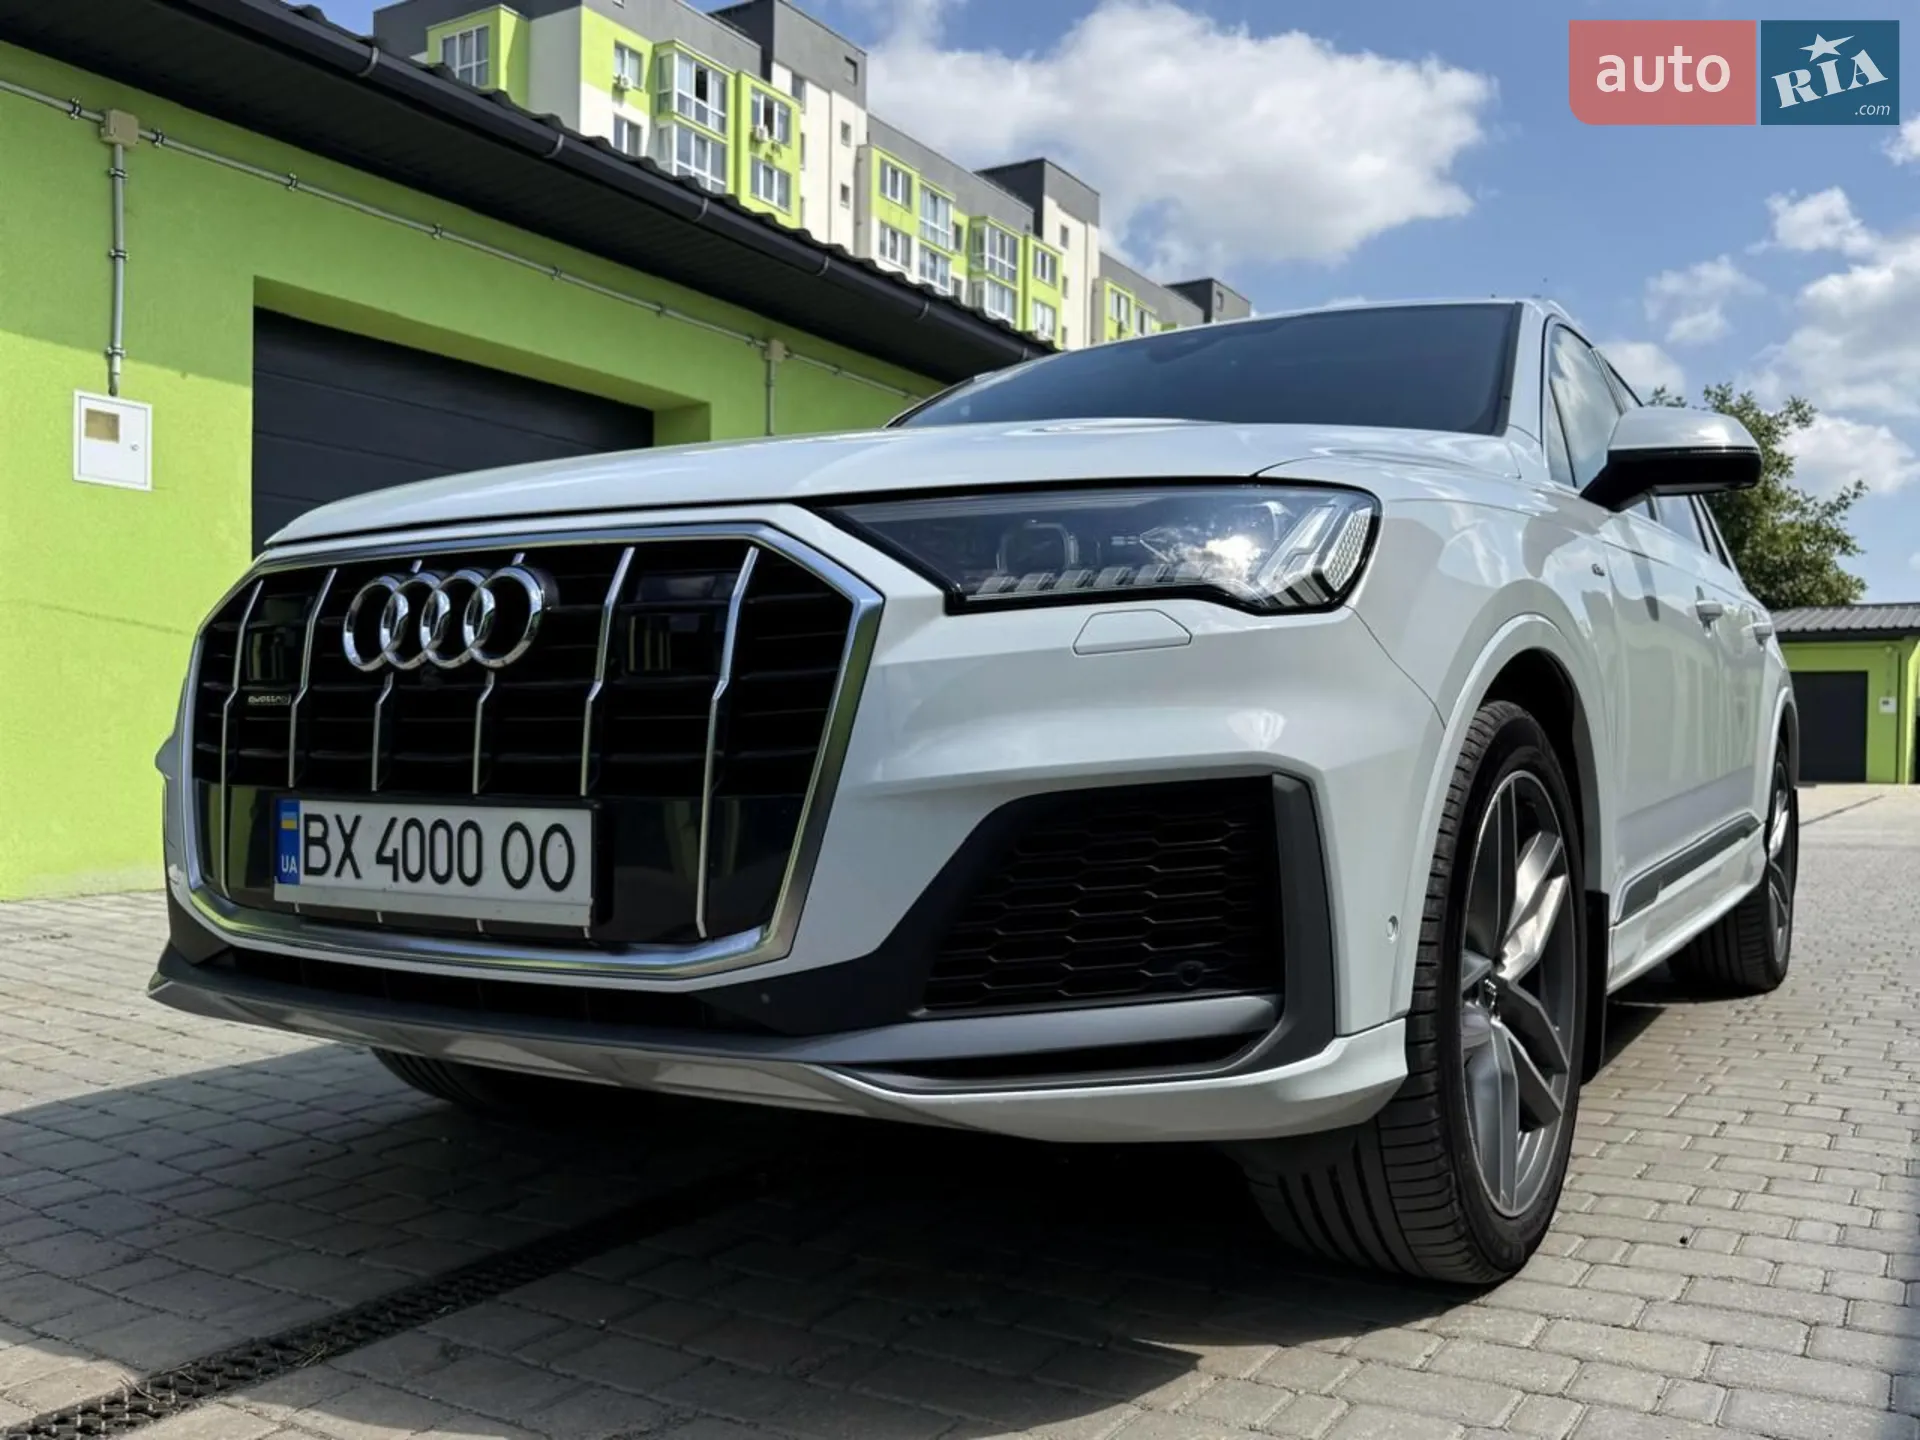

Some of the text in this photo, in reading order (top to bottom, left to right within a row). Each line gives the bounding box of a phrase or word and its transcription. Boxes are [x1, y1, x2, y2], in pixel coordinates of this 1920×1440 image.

[281, 853, 298, 874] UA
[303, 812, 362, 879] BX
[376, 816, 483, 887] 4000
